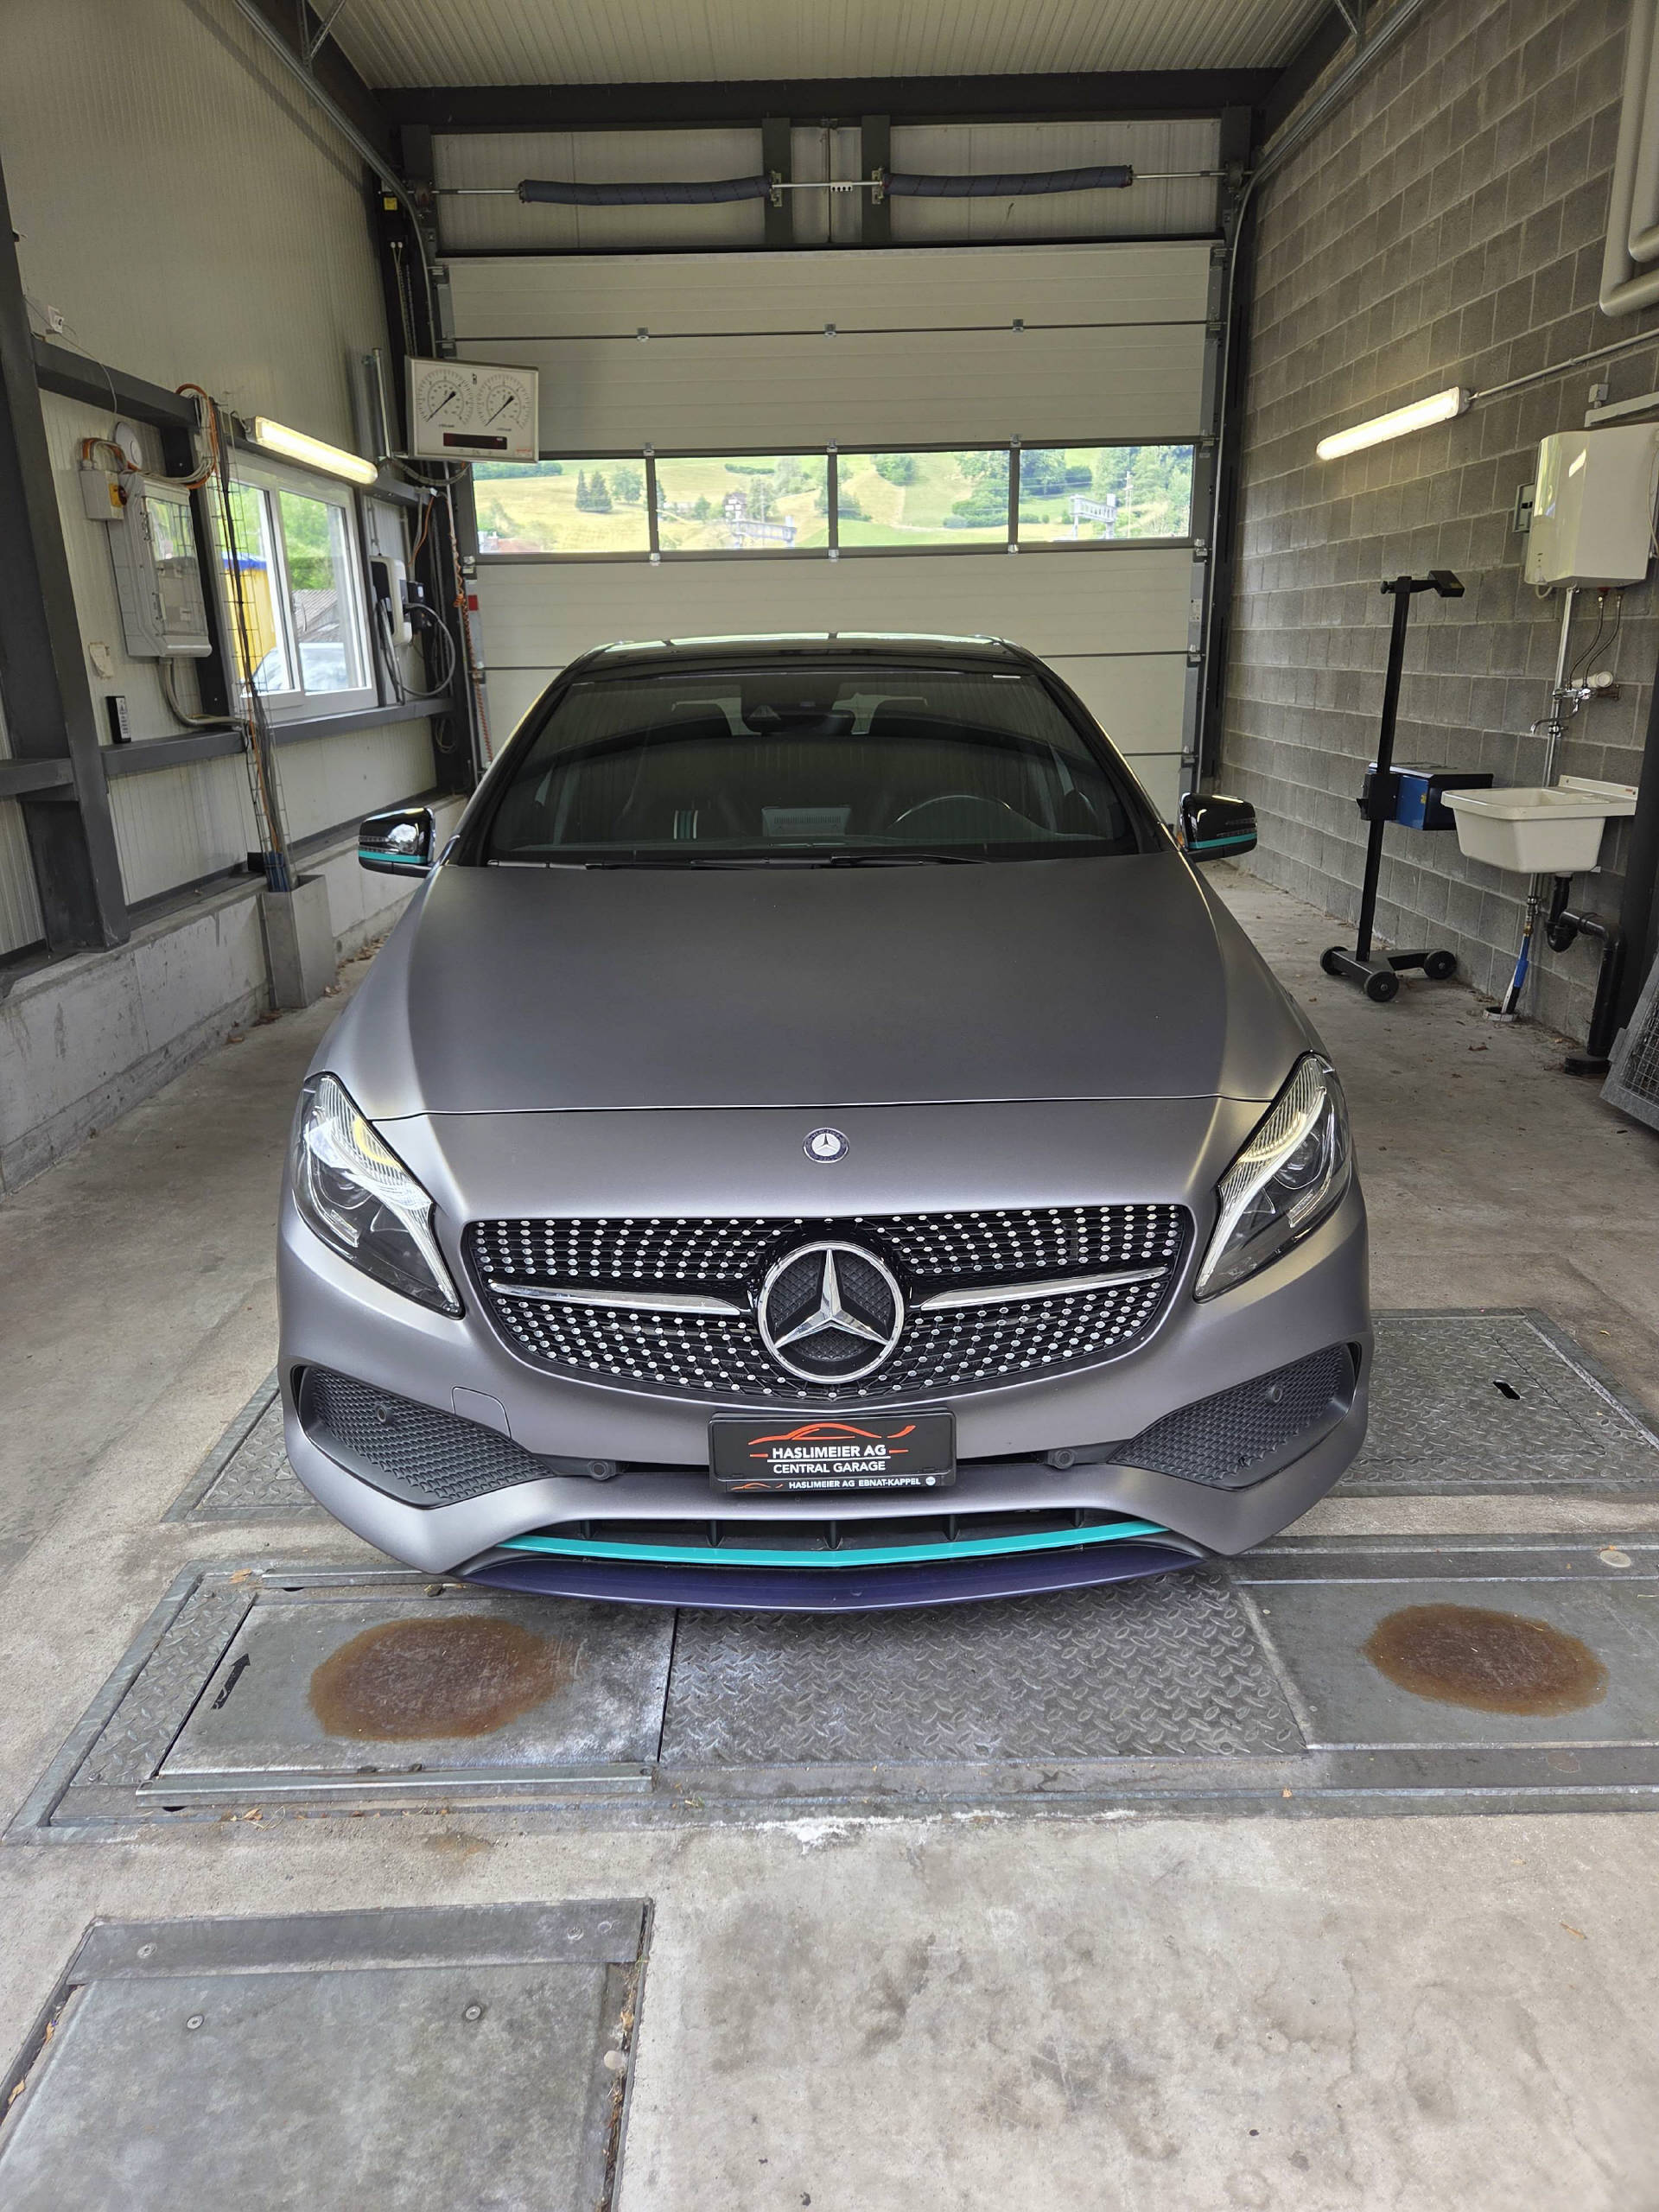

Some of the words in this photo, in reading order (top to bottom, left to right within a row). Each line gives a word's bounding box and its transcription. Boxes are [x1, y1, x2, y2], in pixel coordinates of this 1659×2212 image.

[772, 1446, 861, 1459] HASLIMEIER
[863, 1444, 887, 1456] AG
[773, 1463, 830, 1474] CENTRAL
[833, 1460, 886, 1472] GARAGE
[789, 1480, 841, 1490] HASLIMEIER
[858, 1478, 921, 1487] EBNAT-KAPPEL
